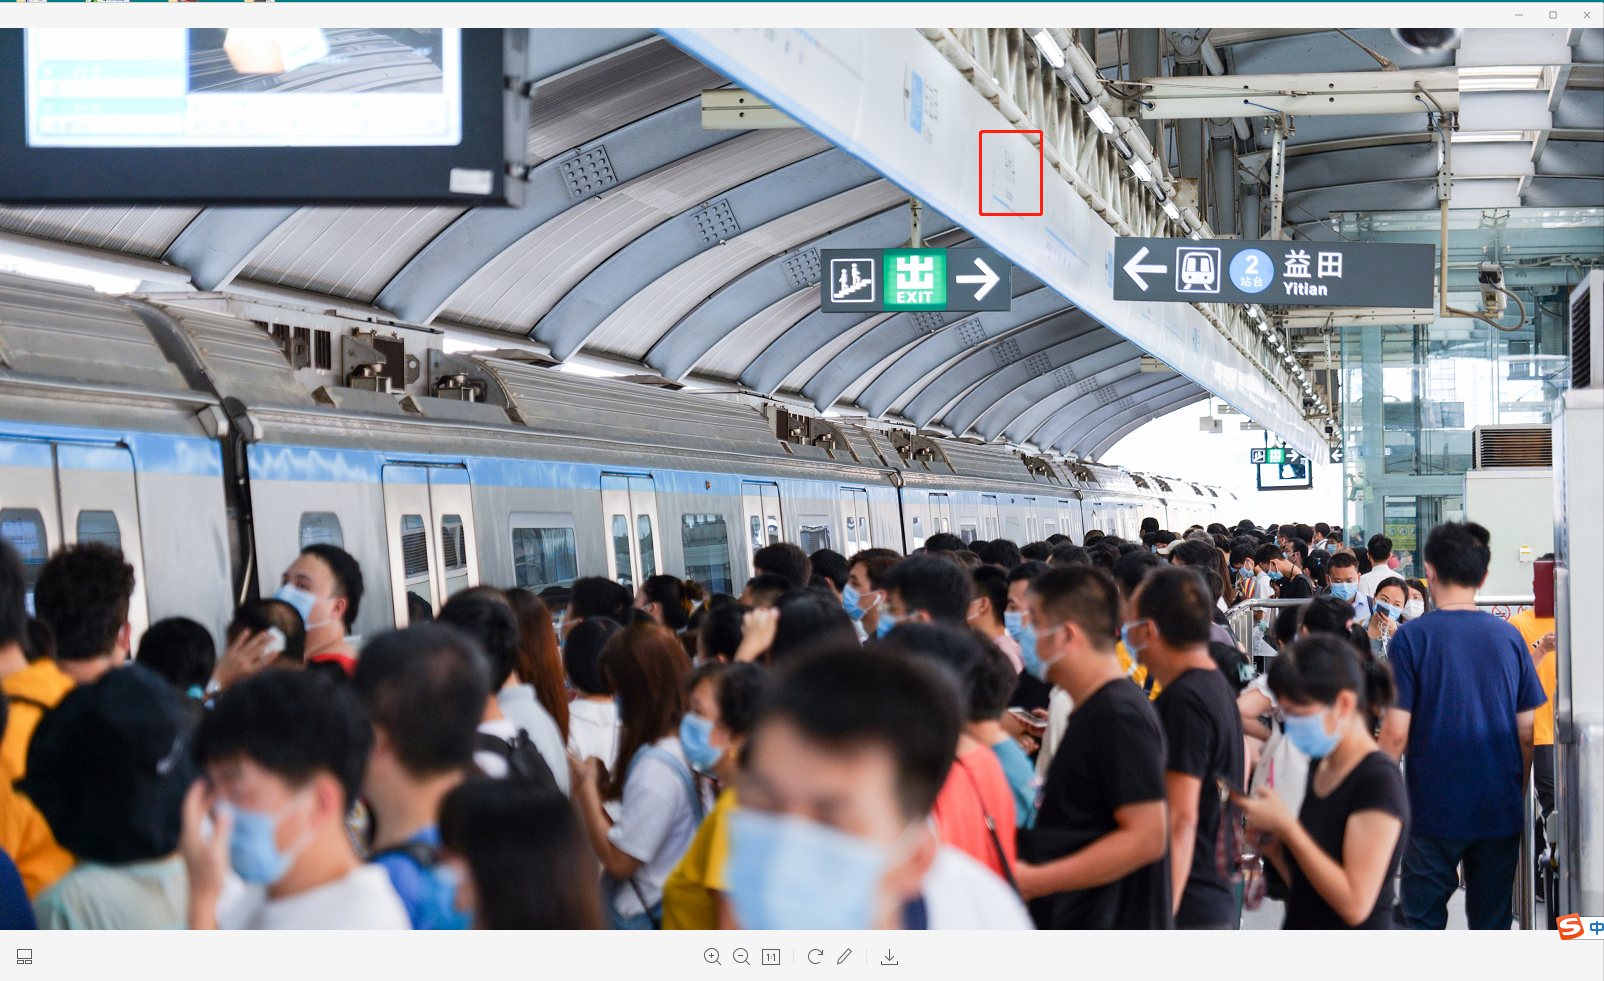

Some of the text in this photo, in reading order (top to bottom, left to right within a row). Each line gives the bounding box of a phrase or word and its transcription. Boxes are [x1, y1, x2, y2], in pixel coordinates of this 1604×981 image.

[896, 255, 934, 290] 出
[1245, 254, 1259, 275] 2
[1283, 249, 1343, 278] 益田
[1240, 276, 1263, 288] 站台
[1283, 281, 1328, 297] Yitian
[896, 291, 934, 304] EXIT
